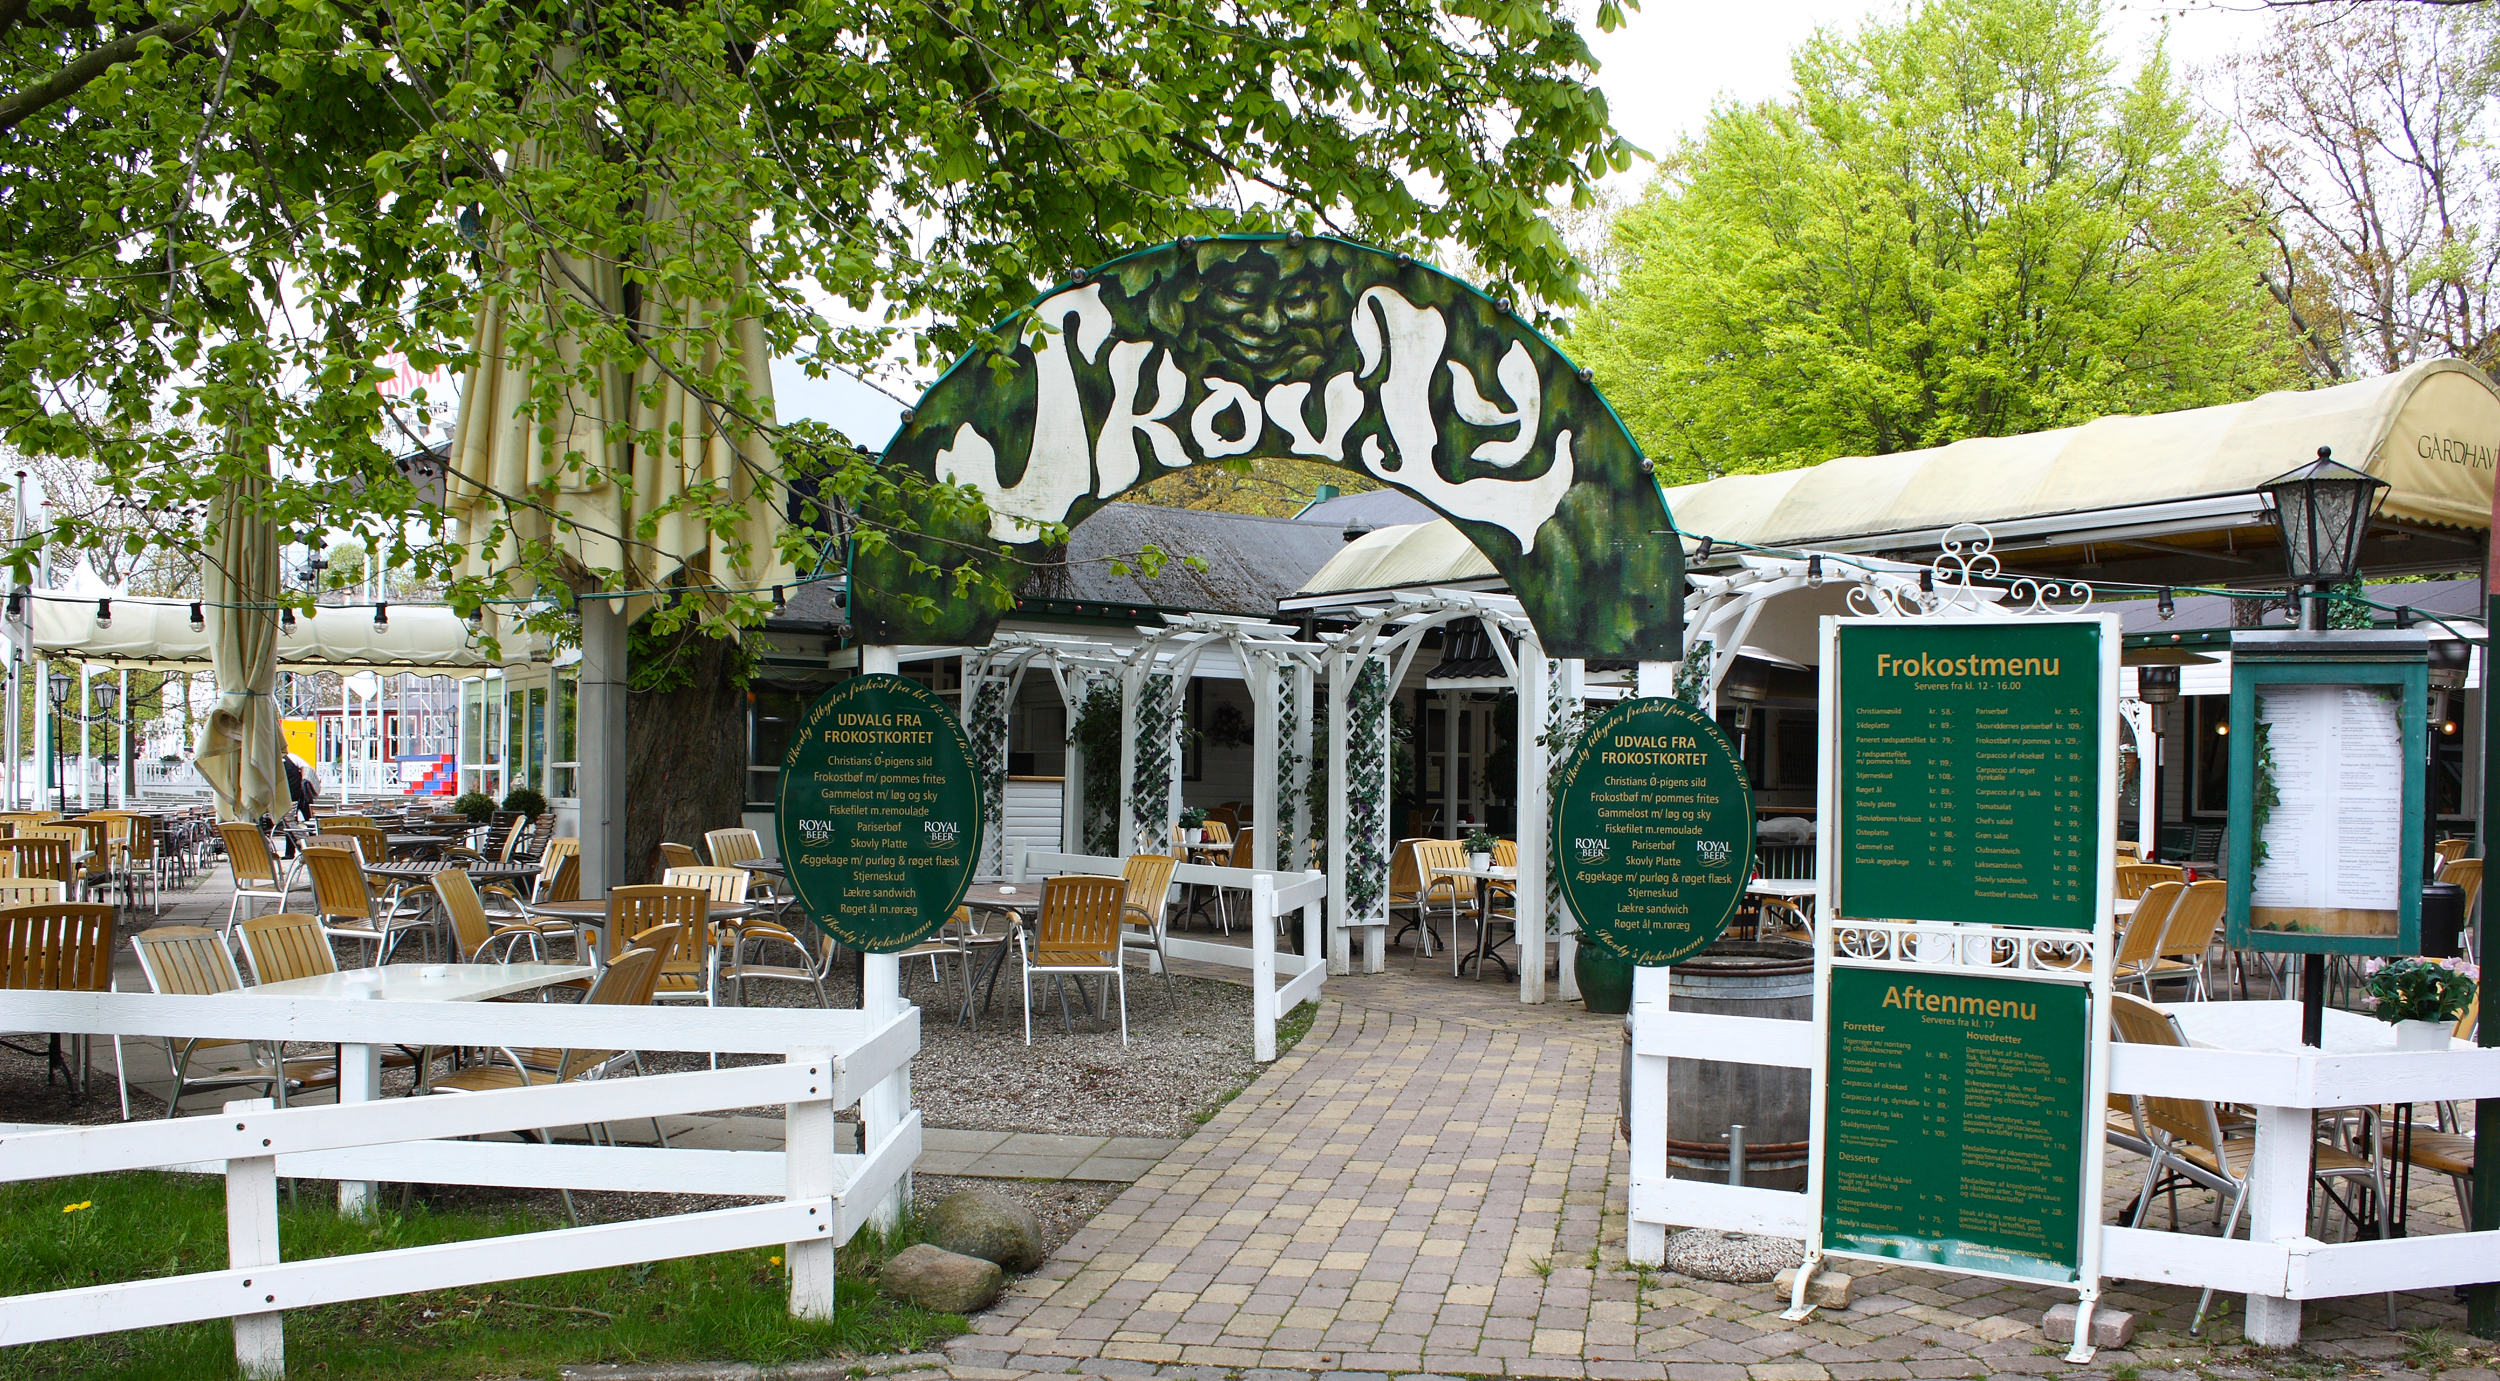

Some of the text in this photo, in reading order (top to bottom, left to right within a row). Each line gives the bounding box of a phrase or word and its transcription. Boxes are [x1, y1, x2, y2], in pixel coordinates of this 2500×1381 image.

[2418, 432, 2499, 469] GÅRDHAV
[1877, 652, 2060, 677] Frokostmenu
[1914, 681, 1949, 691] Serveres
[1951, 681, 1963, 690] fra
[1965, 681, 1975, 690] kl.
[1978, 682, 1989, 690] 12
[1997, 681, 2022, 690] 16.00
[786, 726, 812, 766] Skovly
[809, 691, 847, 726] tilbyder
[850, 679, 891, 700] frokost
[888, 680, 910, 694] fra
[912, 688, 930, 703] kl.
[838, 713, 922, 727] UDVALG FRA
[824, 730, 933, 744] FROKOSTKORTET
[1615, 735, 1697, 749] UDVALG FRA
[1856, 736, 1881, 744] Paneret
[1881, 736, 1927, 745] rødspættefilet
[1564, 747, 1590, 787] Skovly
[1587, 714, 1624, 748] tilbyder
[1626, 703, 1666, 723] frokost
[1664, 703, 1686, 717] fra
[1687, 712, 1702, 726] kl.
[828, 755, 932, 769] Christians Ø-pigens sild
[1602, 751, 1708, 766] FROKOSTKORTET
[814, 772, 946, 785] Frokostbøf m/ pommes frites
[1604, 776, 1707, 789] Christians Ø-pigens sild
[1856, 772, 1893, 780] Stjerneskud
[822, 788, 938, 803] Gammelost m/ løg og sky
[1591, 791, 1720, 805] Frokostbøf m/ pommes frites
[829, 805, 930, 816] Fiskefilet m.remoulade
[1856, 801, 1876, 809] Skovly
[1976, 802, 2012, 810] Tomatsalat
[1597, 807, 1712, 822] Gammelost m/ løg og sky
[800, 819, 835, 832] ROYAL
[857, 822, 902, 832] Pariserbøf
[924, 821, 960, 833] ROYAL
[1605, 823, 1703, 835] Fiskefilet m.remoulade
[806, 831, 829, 840] BEER
[931, 832, 955, 842] BEER
[1856, 829, 1889, 837] Osteplatte
[850, 838, 908, 850] Skovly Platte
[1575, 837, 1610, 850] ROYAL
[1632, 840, 1676, 850] Pariserbøf
[1696, 840, 1732, 852] ROYAL
[1975, 846, 2021, 854] Clubsandwich
[1582, 848, 1604, 858] BEER
[1703, 851, 1726, 861] BEER
[800, 854, 960, 868] Æggekage m/ purløg & røget flæsk
[1626, 855, 1681, 868] Skovly Platte
[1876, 858, 1910, 867] æggekage
[853, 871, 905, 883] Stjerneskud
[1575, 871, 1733, 886] Æggekage m/ purløg & røget flæsk
[843, 887, 916, 898] Lækre sandwich
[1628, 887, 1679, 899] Stjerneskud
[840, 903, 918, 917] Røget ål m.røræg
[1617, 902, 1689, 914] Lækre sandwich
[1614, 918, 1691, 932] Røget ål m.røræg
[864, 920, 932, 950] frokostmenu
[1637, 936, 1704, 965] frokostmenu
[1881, 985, 2037, 1021] Aftenmenu
[1843, 1022, 1885, 1033] Forretter
[1921, 1014, 1995, 1029] Serveres fra kl. 17
[1966, 1031, 2022, 1045] Hovedretter
[1843, 1066, 1873, 1074] mozarella
[1841, 1079, 1872, 1088] Carpaccio
[1873, 1080, 1881, 1088] af
[1881, 1082, 1908, 1091] oksekød
[1838, 1151, 1880, 1164] Desserter
